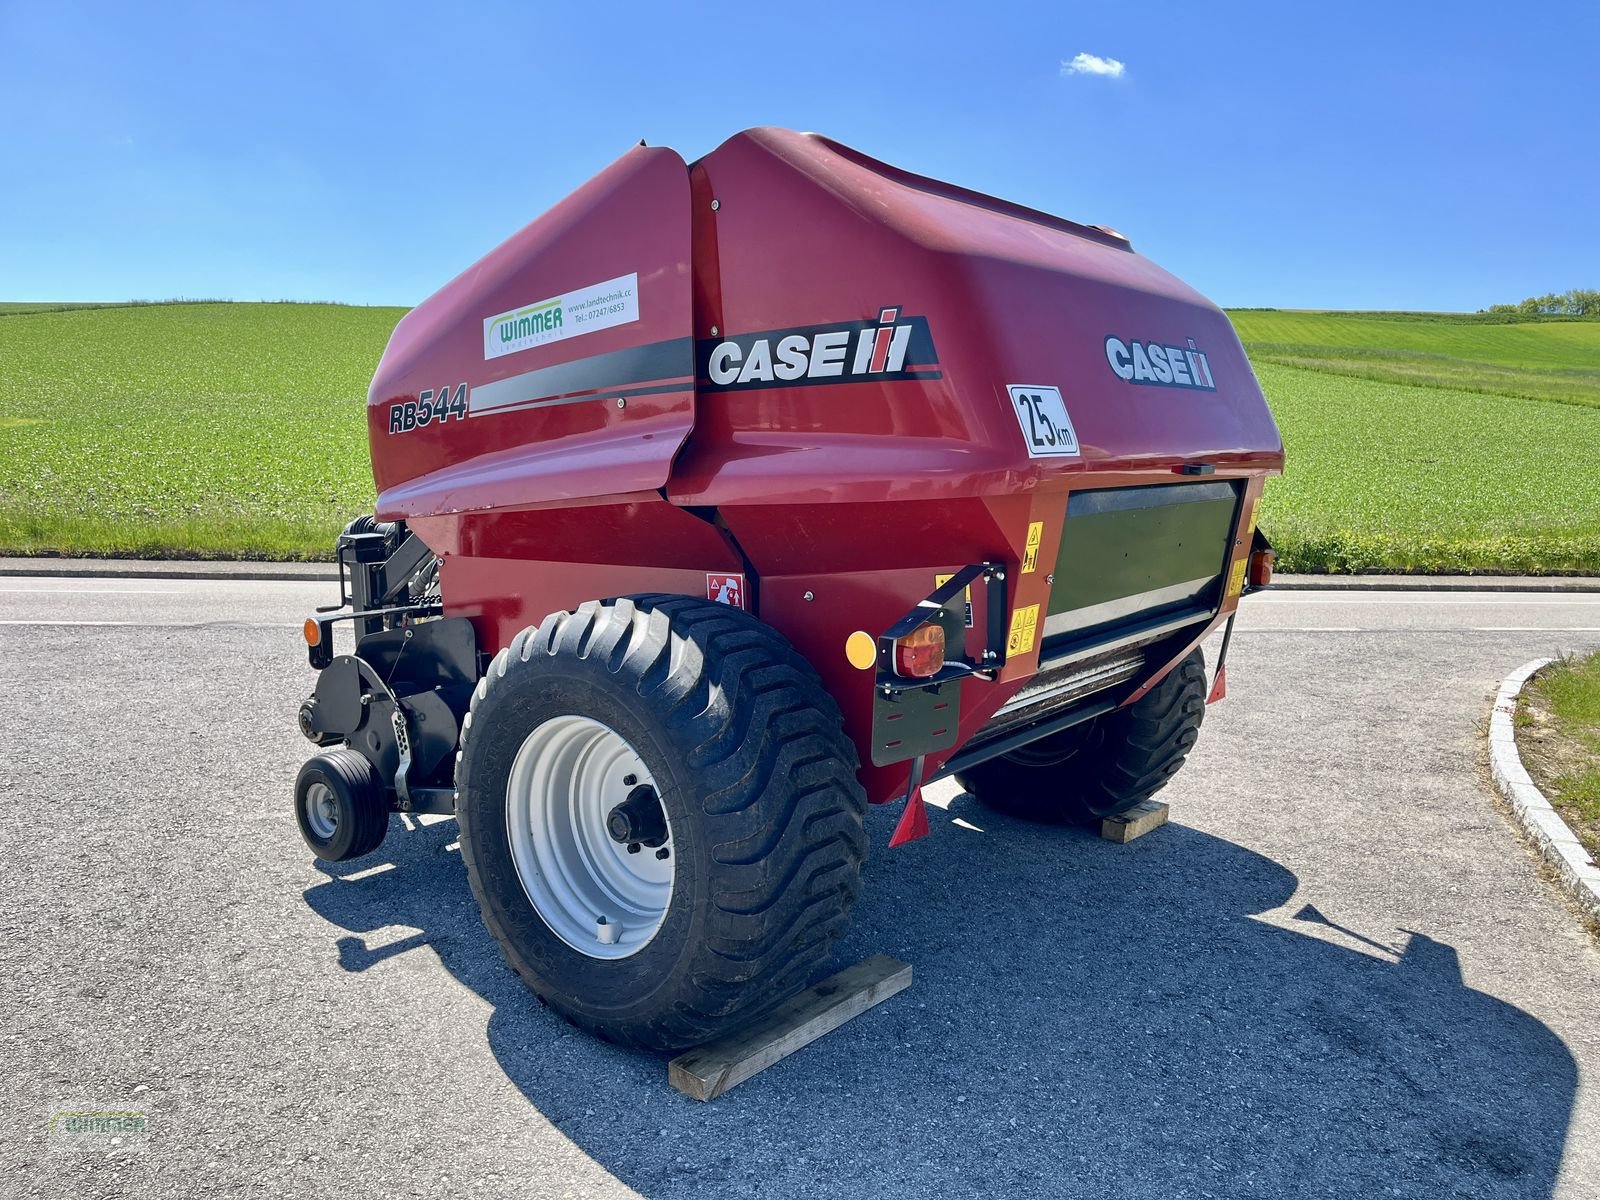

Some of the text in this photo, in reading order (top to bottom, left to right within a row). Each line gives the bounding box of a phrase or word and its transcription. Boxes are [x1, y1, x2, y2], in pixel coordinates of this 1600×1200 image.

[568, 289, 632, 313] www.landtechnik.cc
[589, 302, 625, 319] 07247/6853
[501, 307, 563, 343] WIMMER
[709, 331, 850, 385] CASE
[1105, 337, 1191, 385] CASE
[1019, 394, 1073, 446] 25 km
